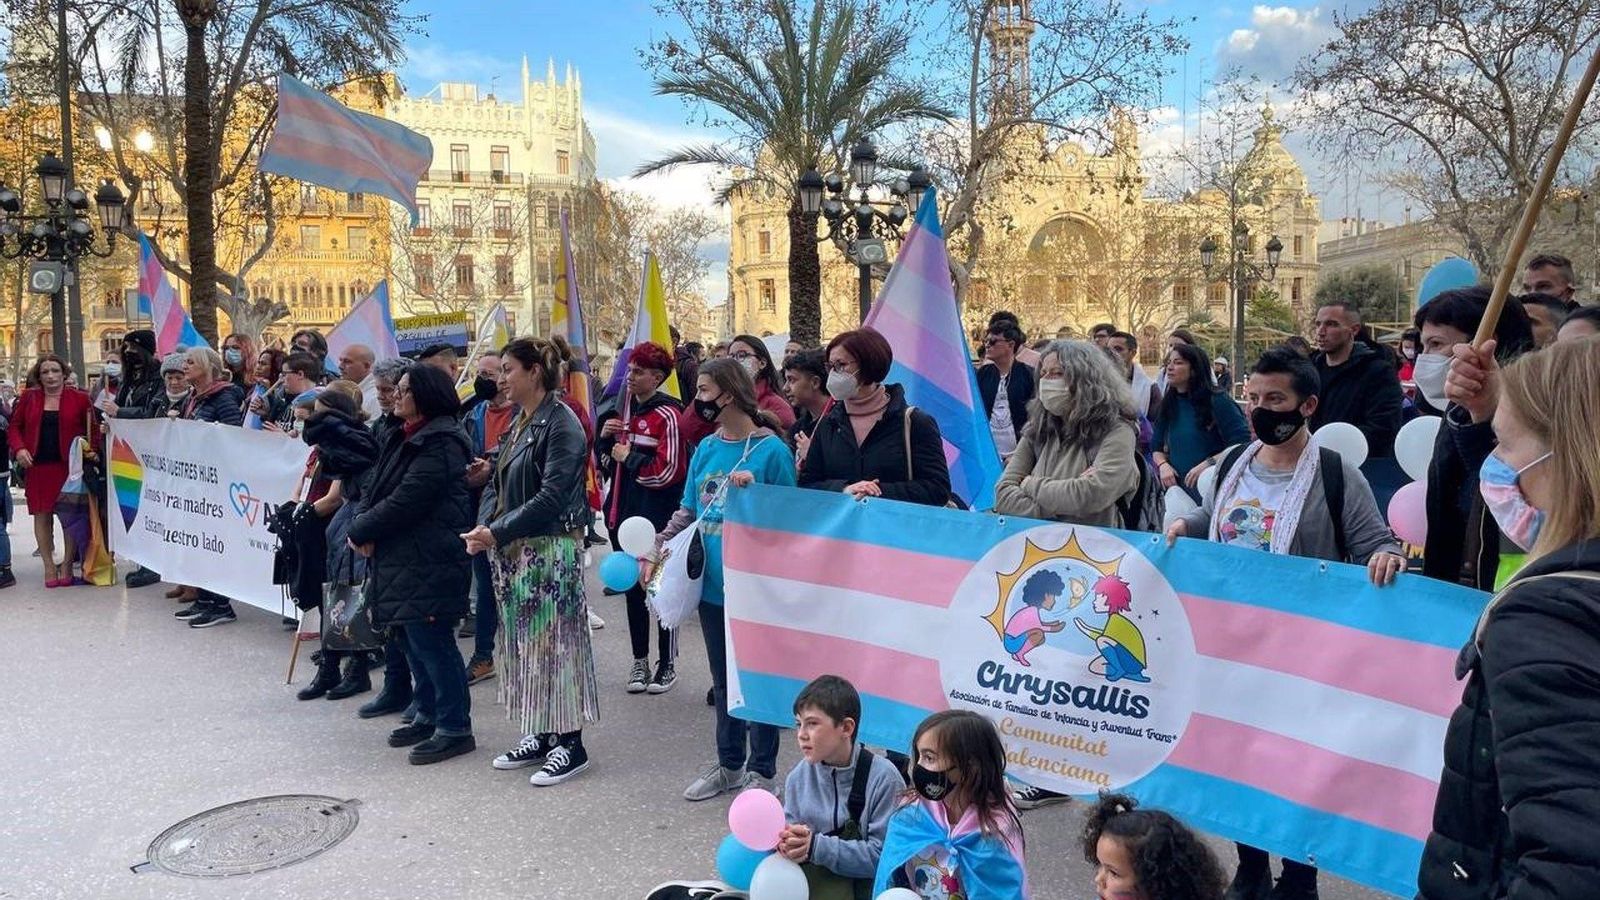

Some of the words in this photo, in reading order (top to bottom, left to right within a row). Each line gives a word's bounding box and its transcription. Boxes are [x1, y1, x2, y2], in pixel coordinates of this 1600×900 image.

[184, 497, 223, 518] madres
[202, 532, 224, 554] lado
[977, 660, 1150, 719] Chrysallis
[949, 689, 990, 707] Asociación
[992, 699, 1002, 709] de
[1005, 700, 1038, 717] Familias
[1040, 710, 1052, 720] de
[1054, 711, 1090, 728] Infancia
[1091, 720, 1099, 733] y
[1100, 720, 1143, 737] Juventud
[1000, 716, 1109, 757] Comunitat
[1004, 744, 1111, 786] alenciana
